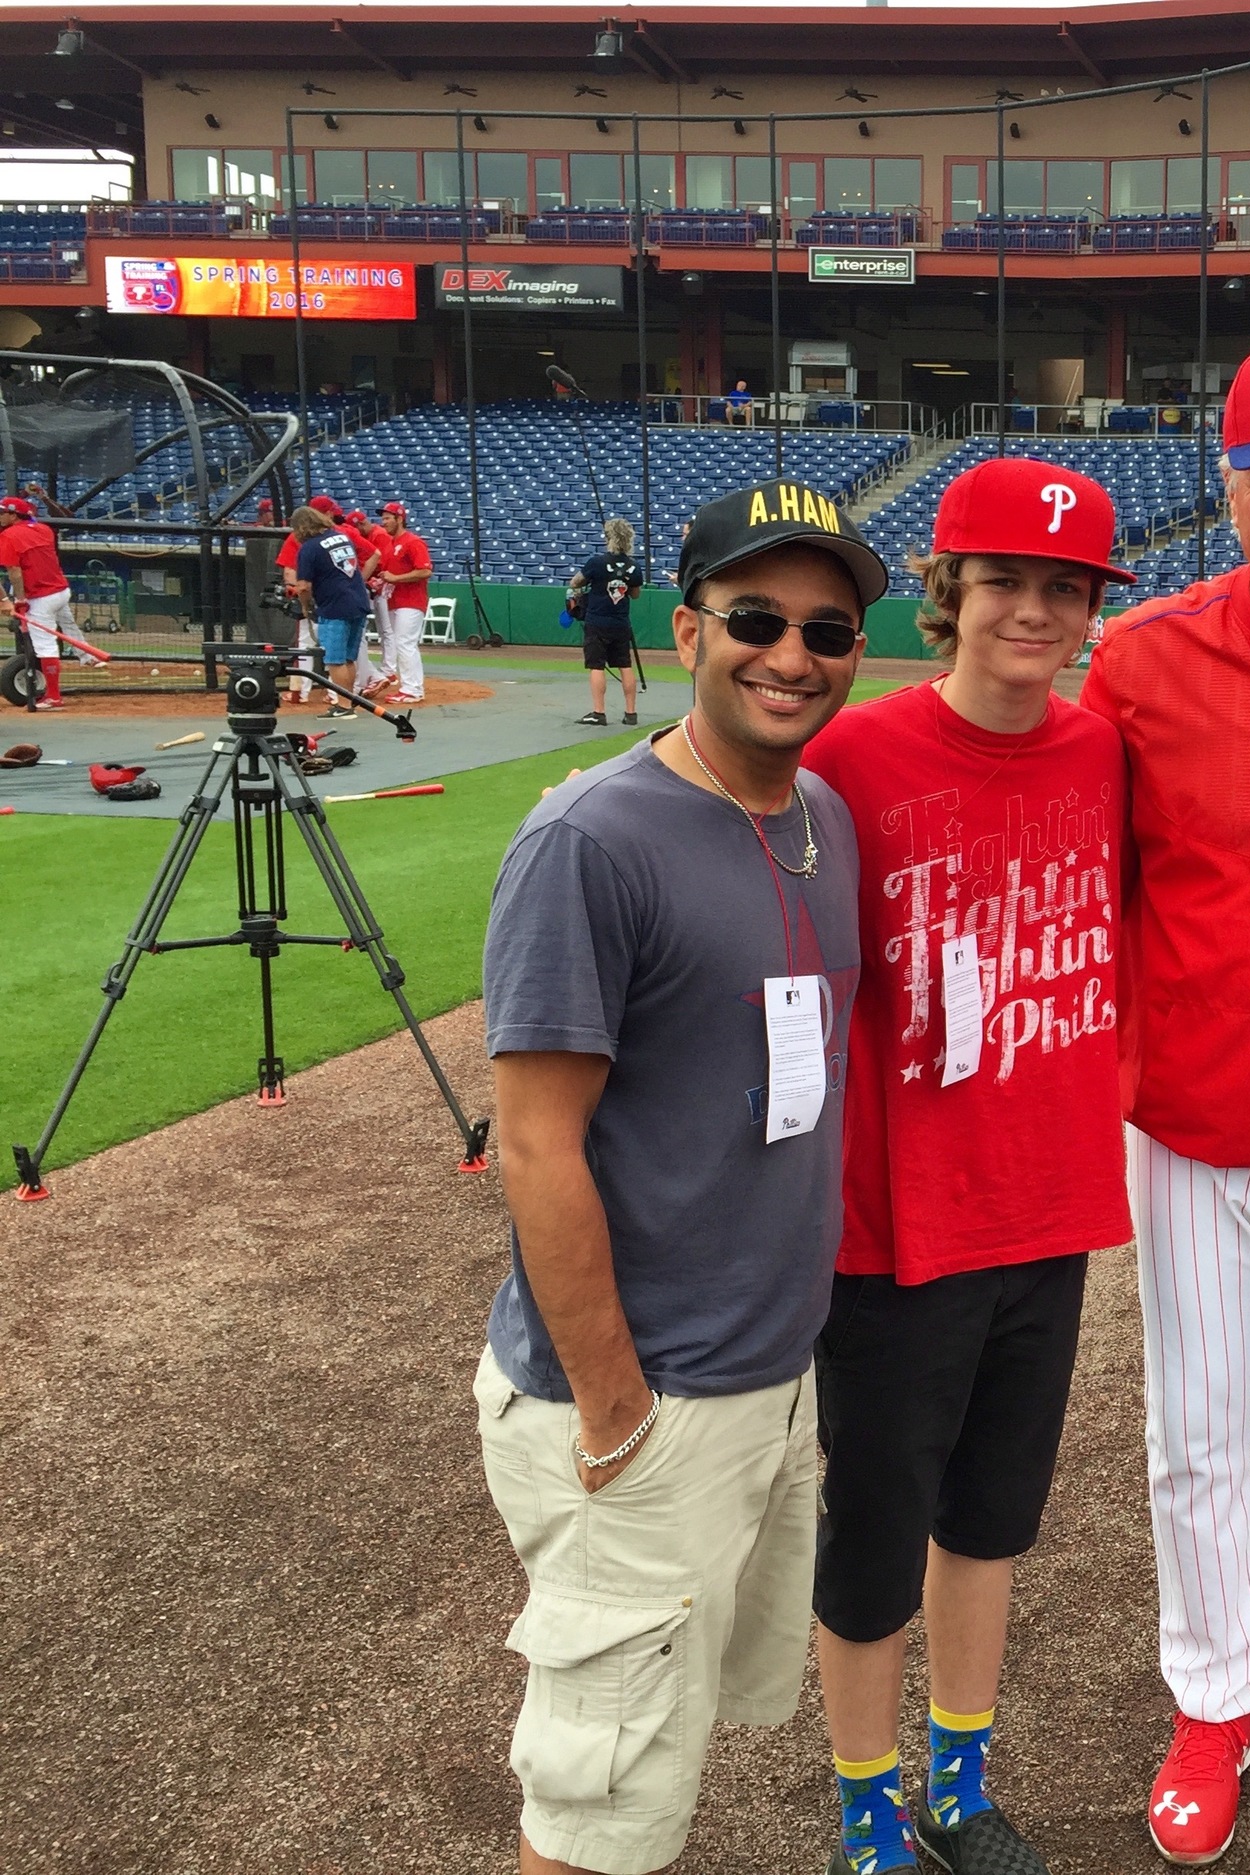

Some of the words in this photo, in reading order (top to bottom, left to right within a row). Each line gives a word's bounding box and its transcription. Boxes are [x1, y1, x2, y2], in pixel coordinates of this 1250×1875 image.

[193, 266, 278, 283] SPRING
[289, 268, 403, 287] TRAINING
[820, 259, 906, 273] enterprise
[441, 269, 511, 291] DEX
[507, 279, 579, 293] imaging
[270, 292, 325, 309] 2016
[486, 295, 523, 303] Solutions:
[527, 296, 556, 304] Copiers
[564, 297, 593, 305] Printers
[750, 484, 840, 534] A.HAM
[1040, 483, 1077, 534] P
